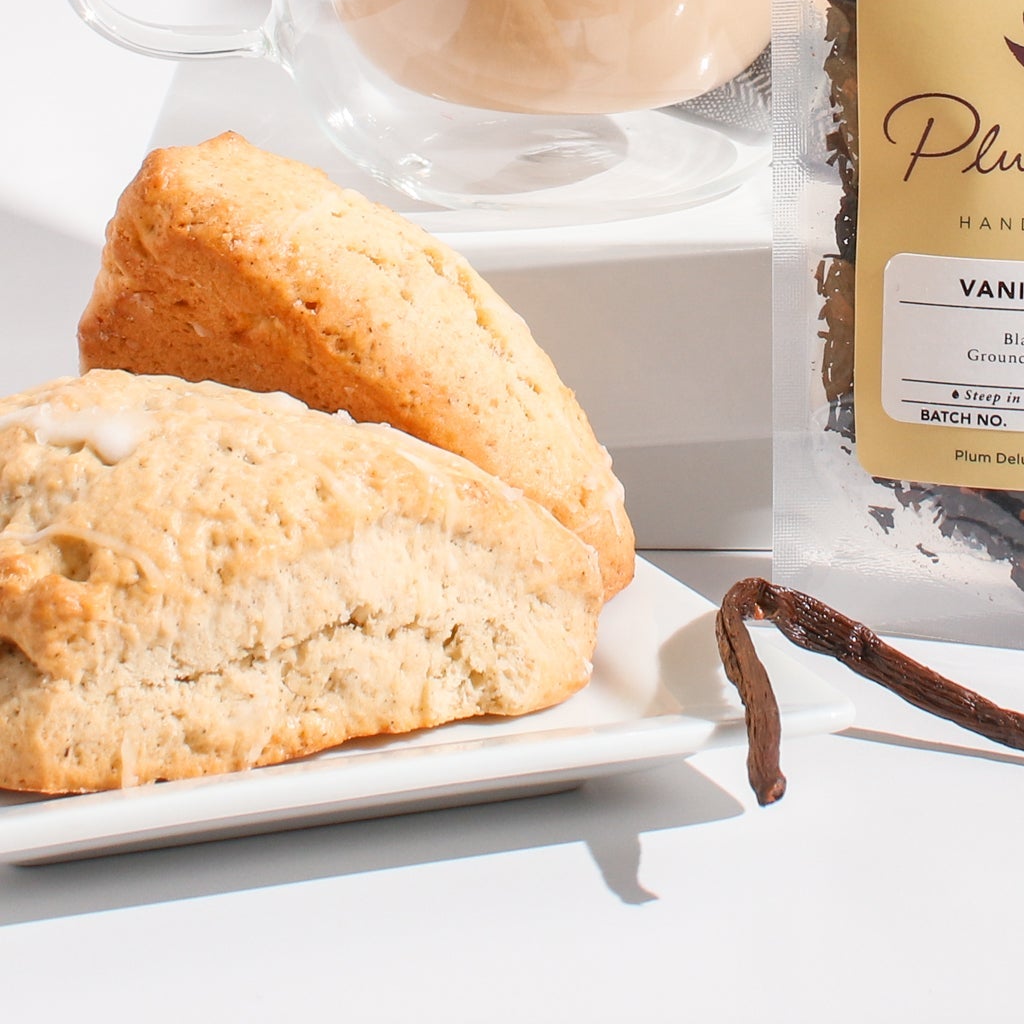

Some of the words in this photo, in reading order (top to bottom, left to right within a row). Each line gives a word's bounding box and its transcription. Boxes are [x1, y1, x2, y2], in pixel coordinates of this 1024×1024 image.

[963, 388, 1002, 406] Steep
[1006, 391, 1021, 404] in
[919, 408, 972, 426] BATCH
[976, 413, 1008, 428] NO.
[954, 448, 993, 464] Plum
